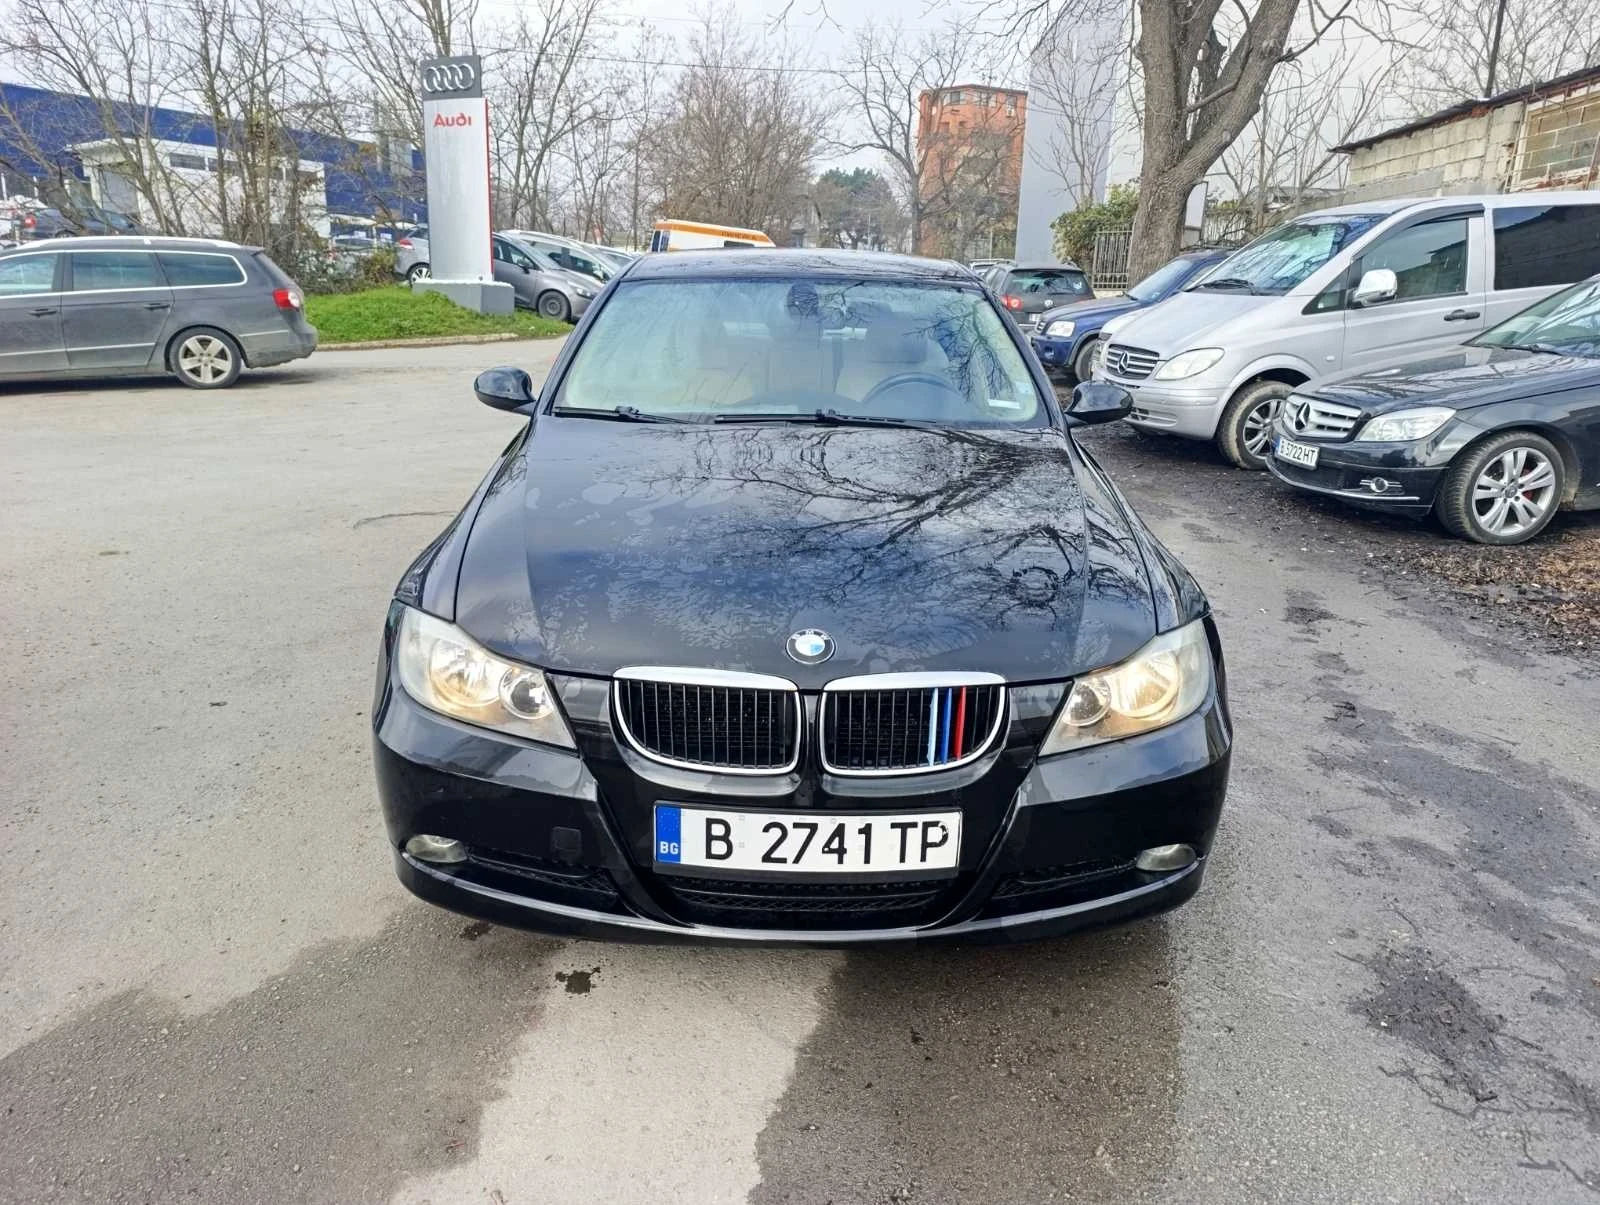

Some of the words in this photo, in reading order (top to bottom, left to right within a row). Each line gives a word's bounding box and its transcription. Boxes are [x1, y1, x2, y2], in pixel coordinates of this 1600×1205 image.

[434, 112, 471, 127] Audi
[660, 841, 679, 855] BG
[705, 817, 733, 860] B
[761, 821, 873, 865] 2741
[890, 820, 949, 863] TP
